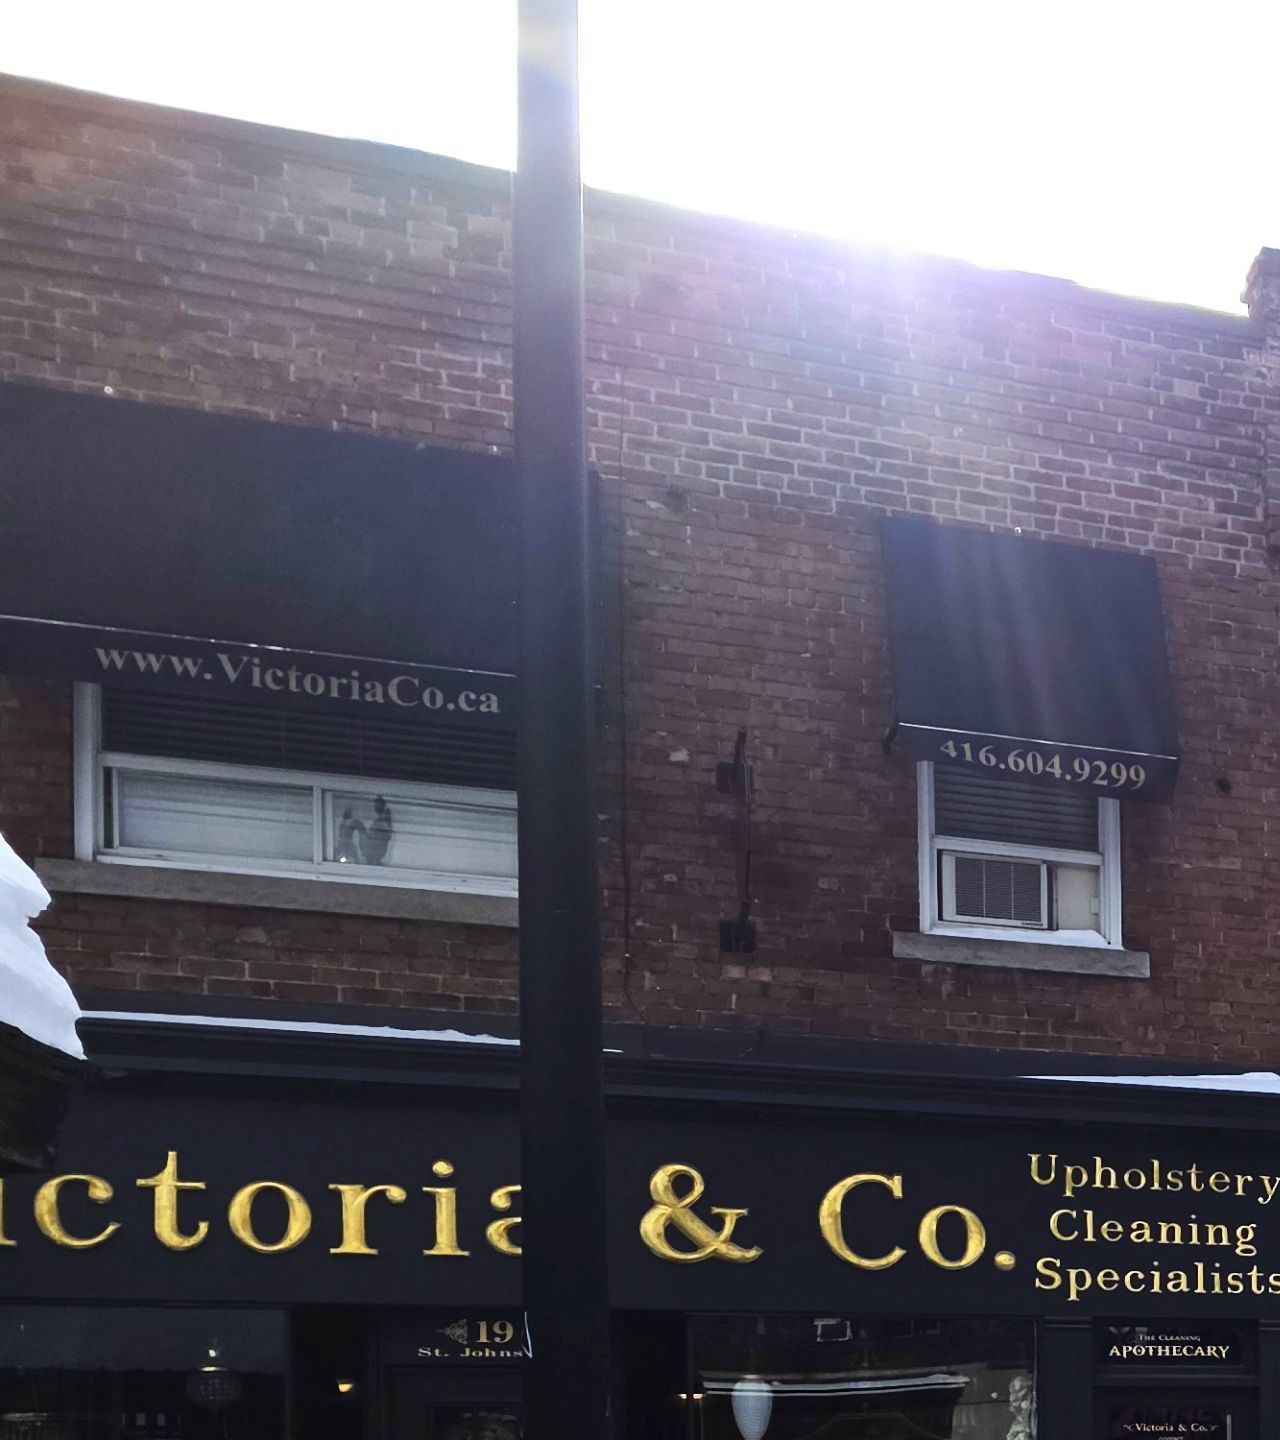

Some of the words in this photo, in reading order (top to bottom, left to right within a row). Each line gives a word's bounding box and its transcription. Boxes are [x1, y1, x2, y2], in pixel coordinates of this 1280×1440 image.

[95, 646, 501, 714] www.VictoriaCo.ca
[940, 740, 1147, 791] 416.604.9299
[638, 1163, 764, 1264] &
[818, 1173, 1017, 1271] Co.
[1049, 1208, 1258, 1257] Cleaning
[475, 1320, 514, 1344] 19
[418, 1347, 450, 1357] St.
[460, 1347, 523, 1357] Johns
[1109, 1344, 1230, 1359] APOTHECARY
[1135, 1423, 1174, 1432] Victoria
[1178, 1423, 1187, 1432] &
